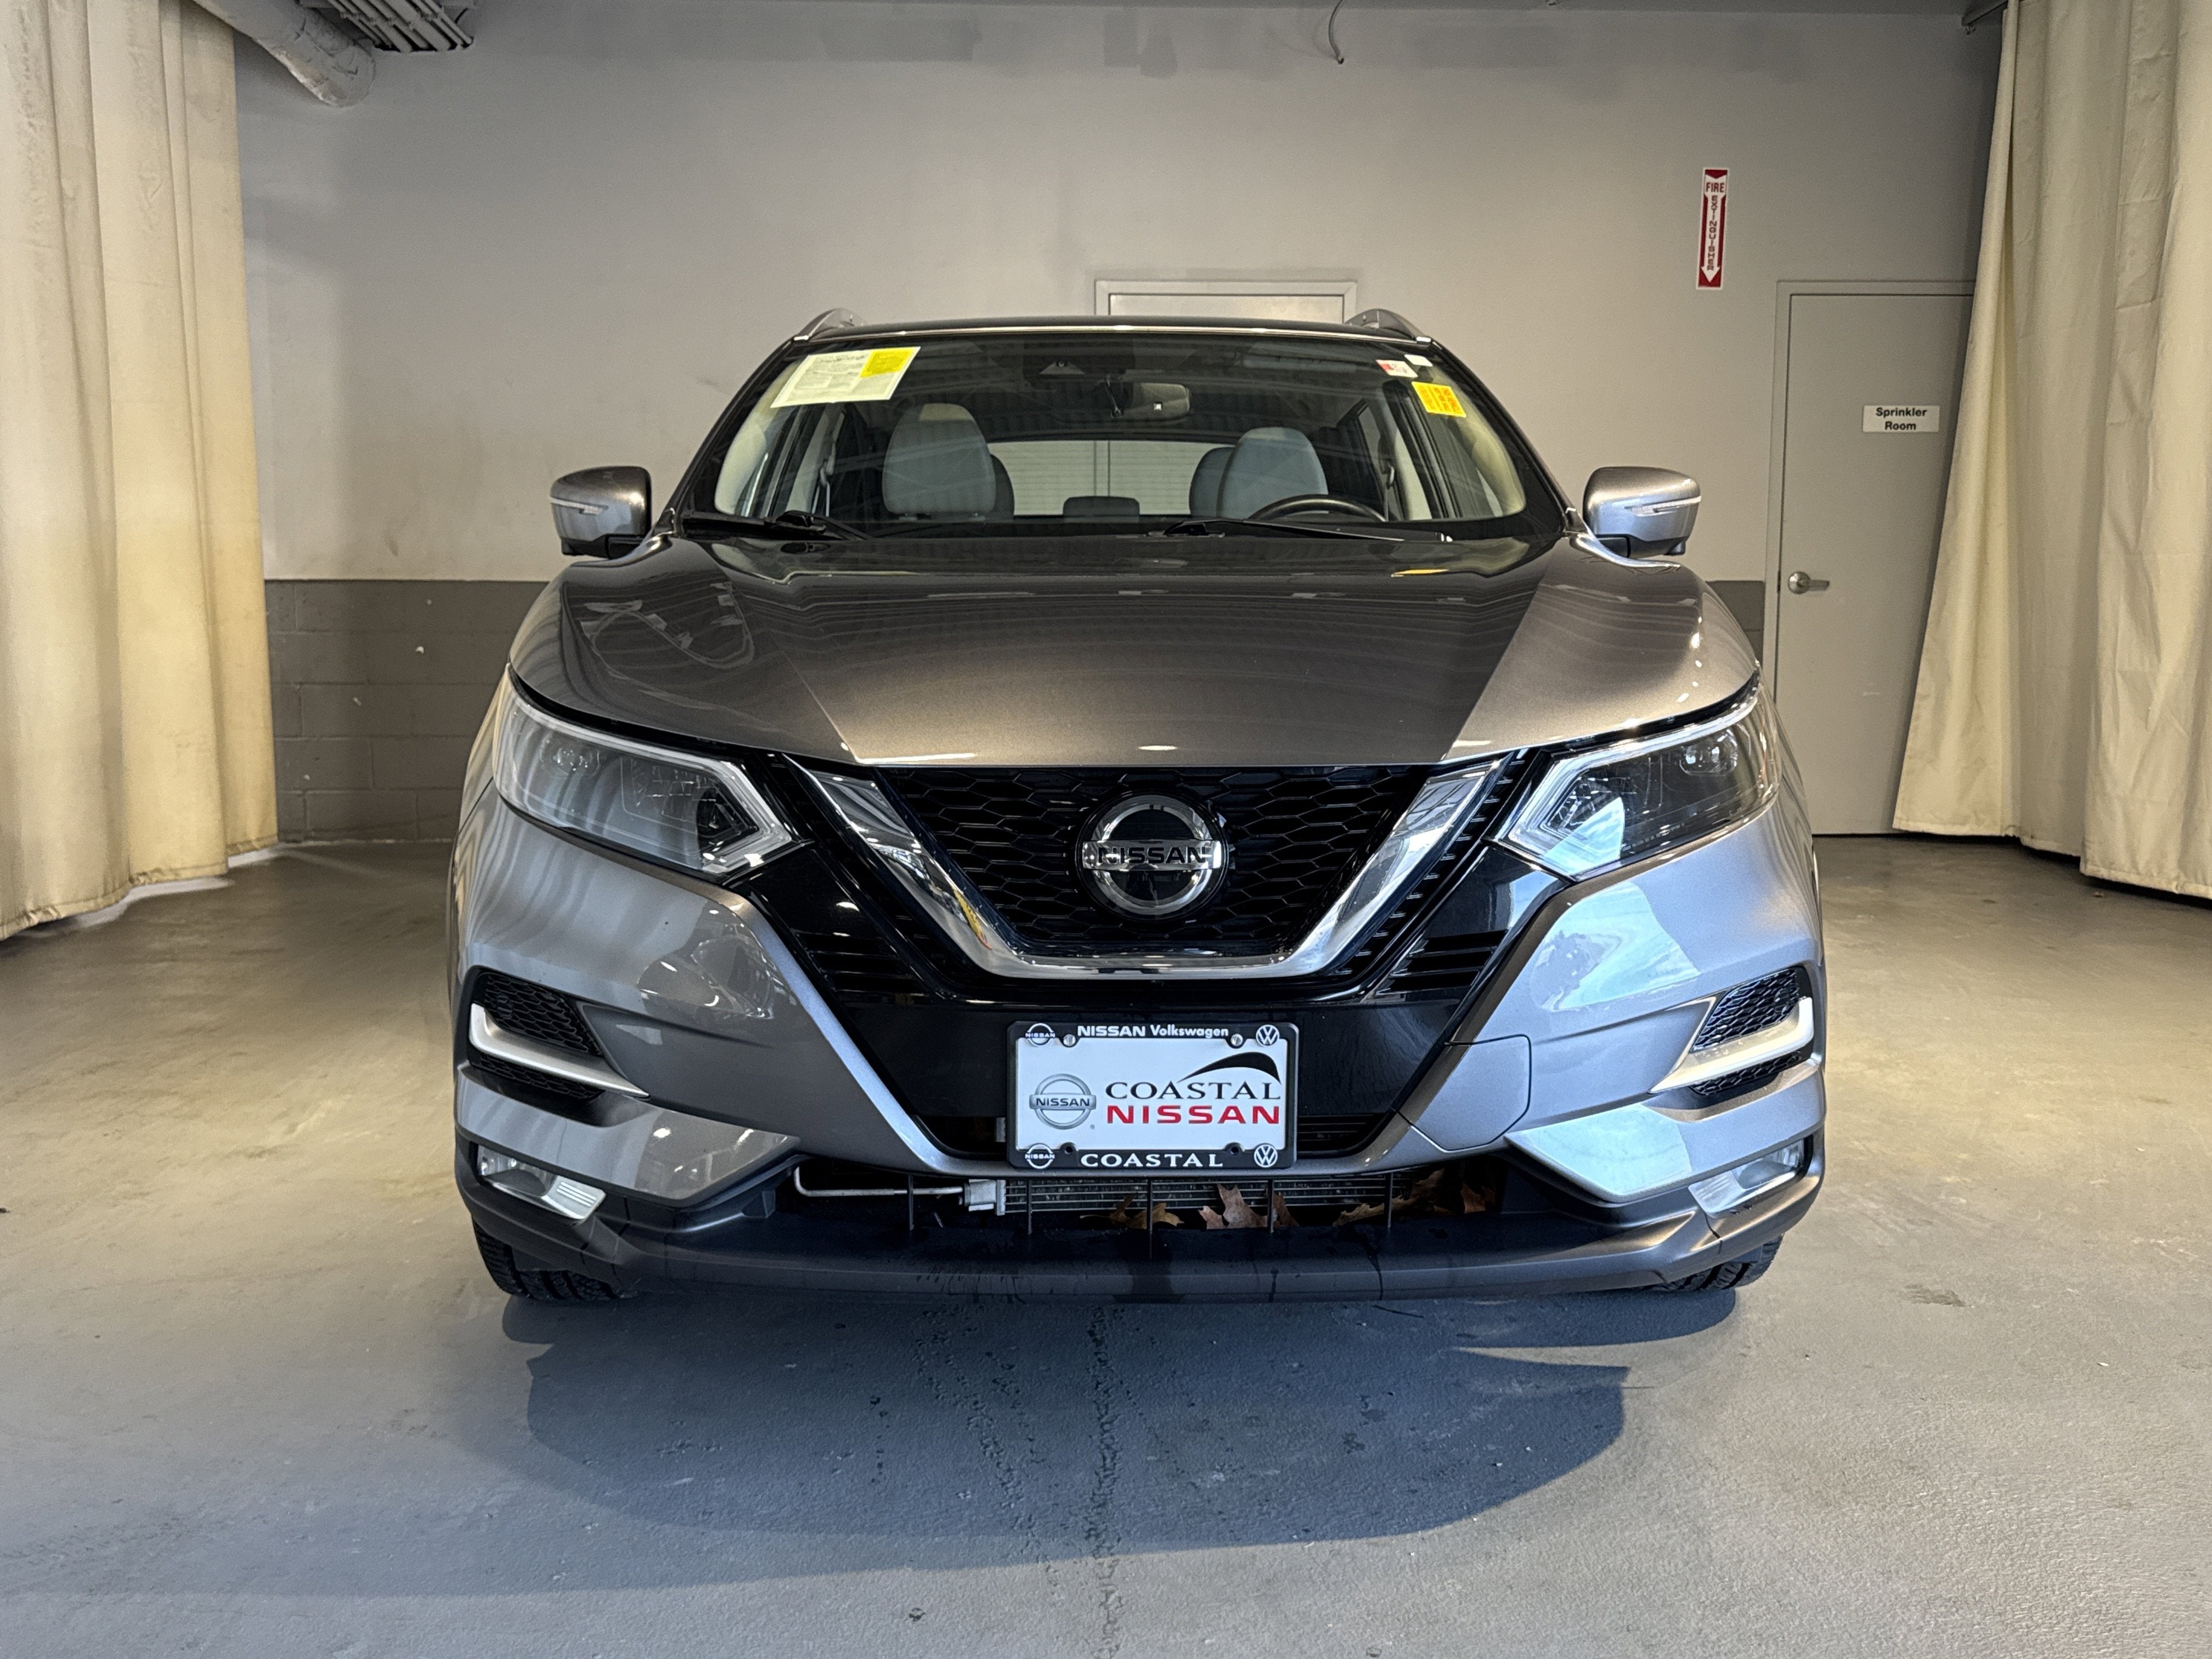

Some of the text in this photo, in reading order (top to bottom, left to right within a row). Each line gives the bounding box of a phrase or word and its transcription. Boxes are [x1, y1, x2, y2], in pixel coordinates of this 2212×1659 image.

[1706, 182, 1725, 193] FIRE
[1707, 195, 1718, 271] EXTINGUISHER
[1875, 407, 1927, 418] Sprinkler
[1884, 421, 1916, 431] Room
[1097, 847, 1207, 864] NISSAN
[1077, 1024, 1229, 1039] NISSAN Volkswagen
[1105, 1080, 1281, 1100] COASTAL
[1036, 1097, 1090, 1107] NISSAN
[1107, 1105, 1279, 1124] NISSAN
[1080, 1153, 1223, 1167] COASTAL
